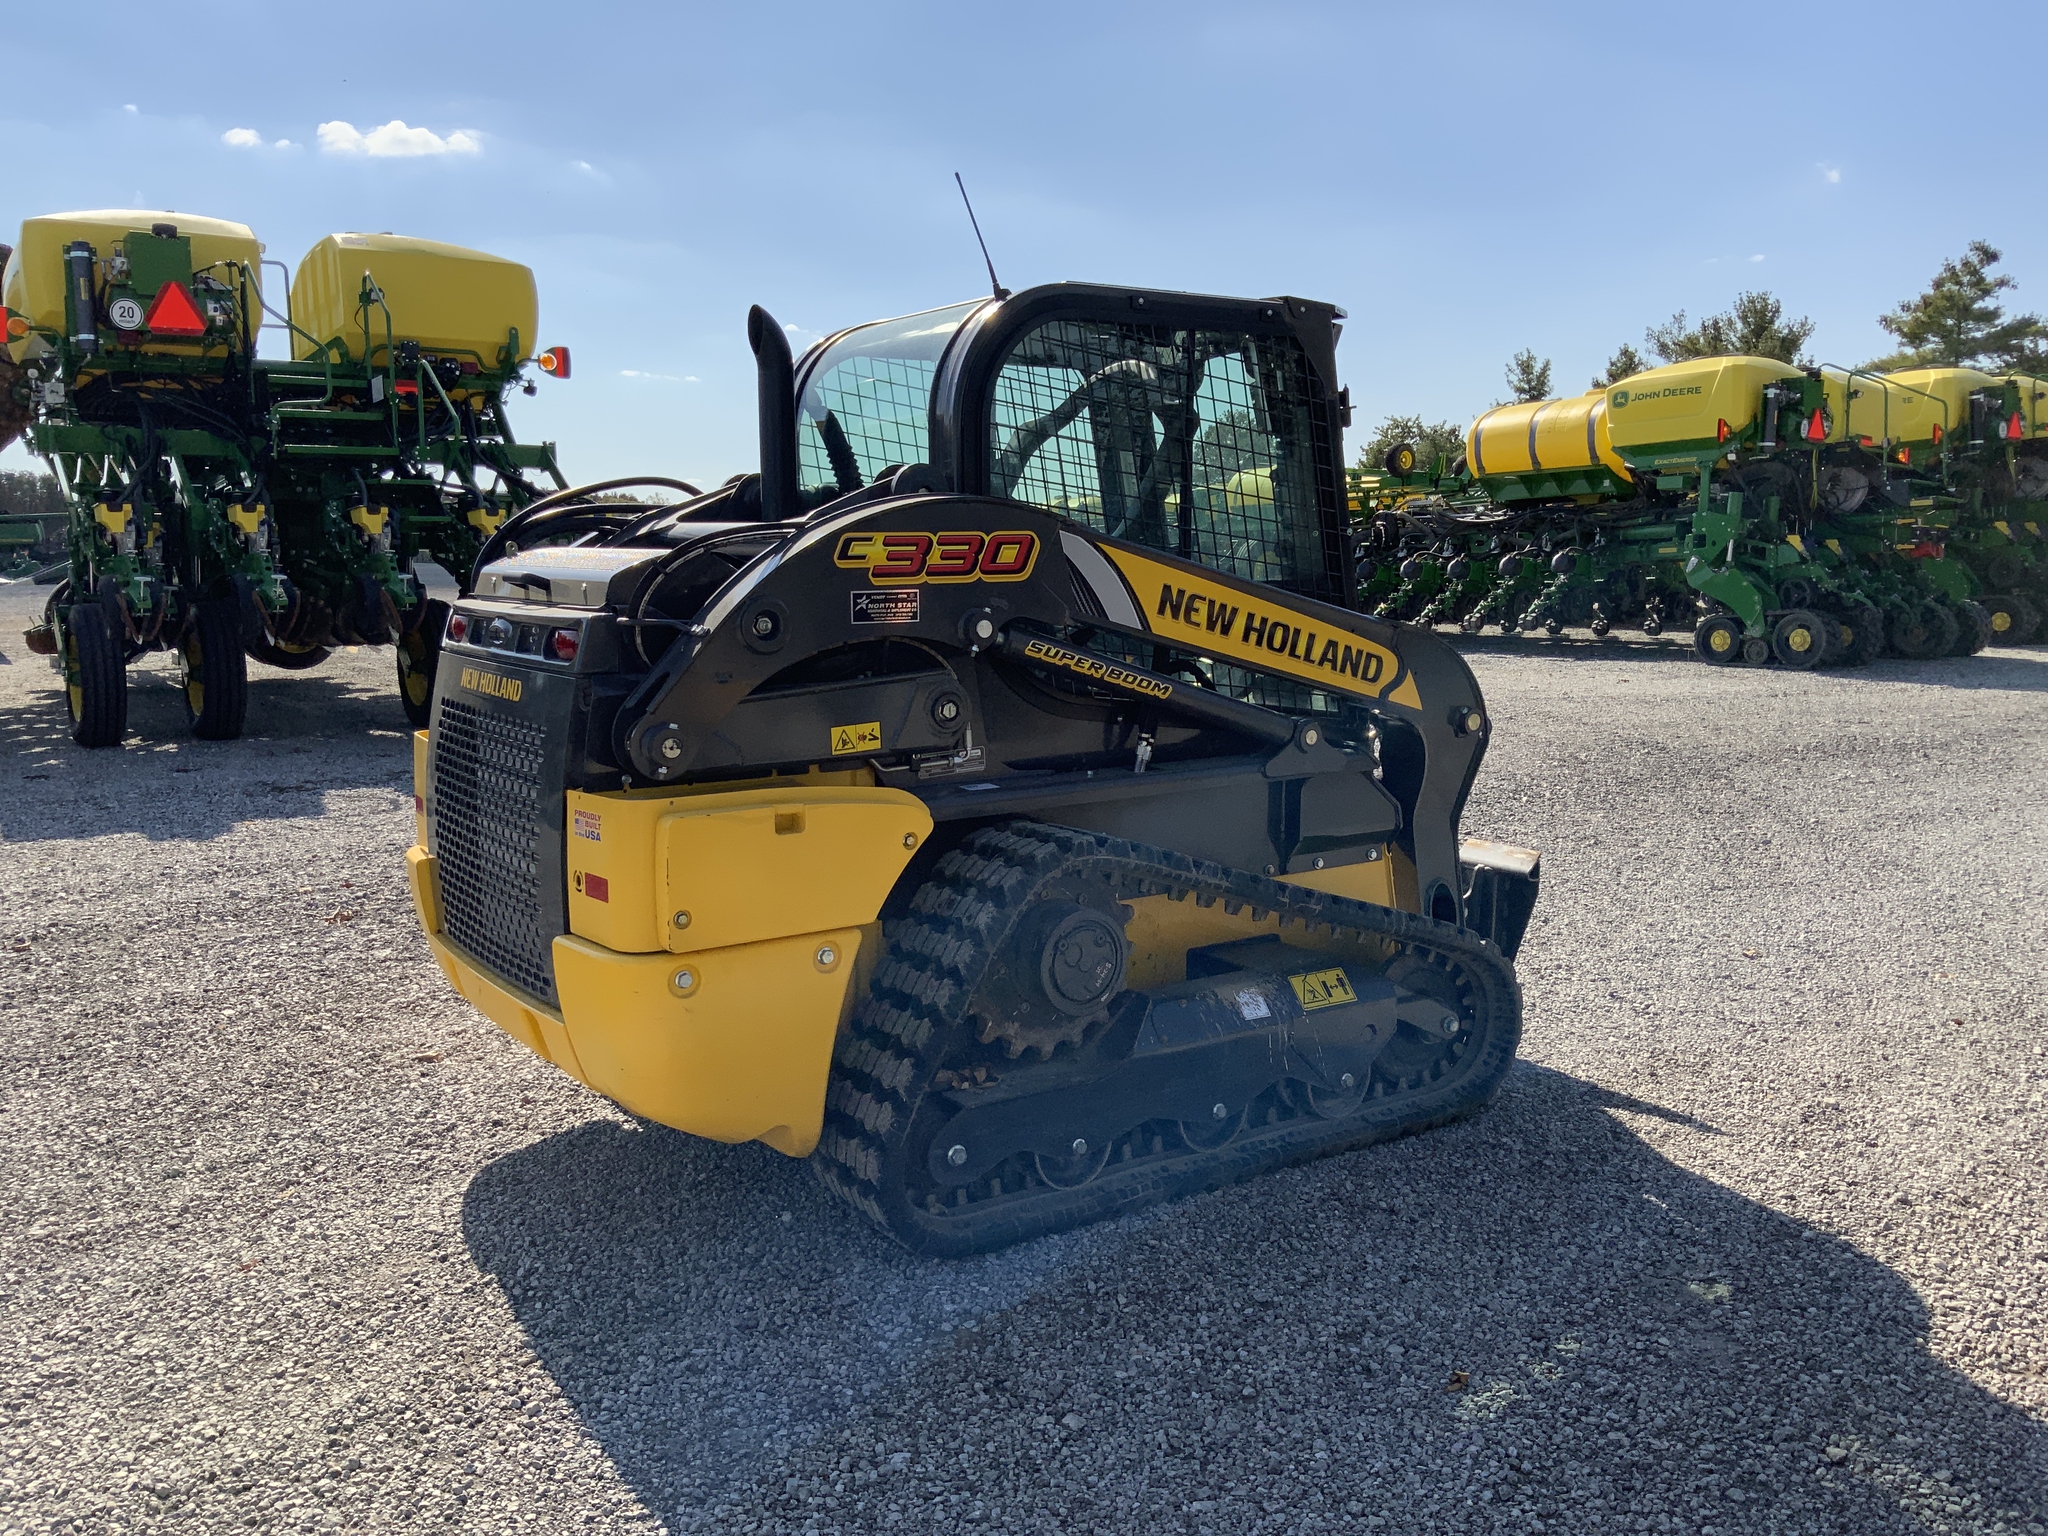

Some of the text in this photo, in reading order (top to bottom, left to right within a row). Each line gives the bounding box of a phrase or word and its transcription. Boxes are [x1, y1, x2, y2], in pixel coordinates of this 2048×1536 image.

[118, 306, 134, 318] 20
[1631, 386, 1702, 402] JOHN DEERE
[836, 533, 1038, 582] C330
[1157, 583, 1383, 684] NEW HOLLAND
[1025, 640, 1172, 699] SUPER BOOM
[461, 667, 522, 702] NEW HOLLAND
[575, 809, 602, 822] PROUDLY
[585, 820, 602, 830] BUILT
[585, 829, 602, 842] USA
